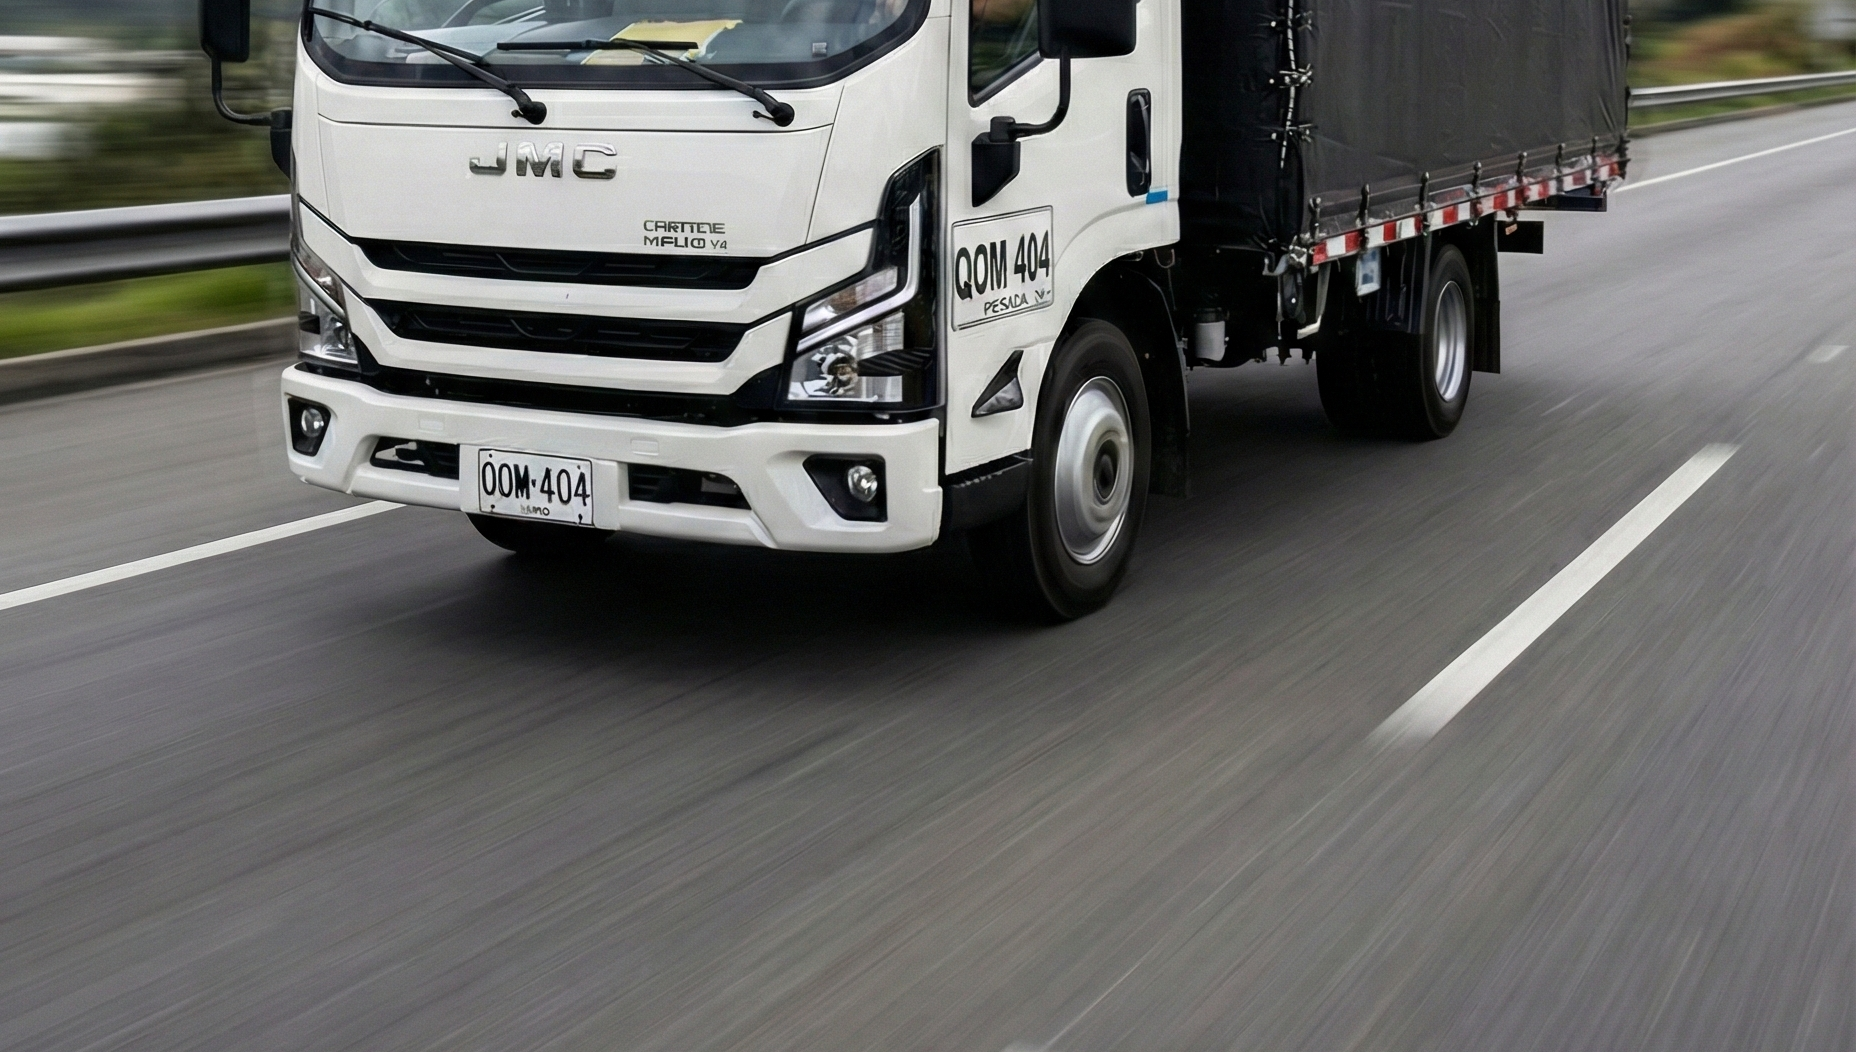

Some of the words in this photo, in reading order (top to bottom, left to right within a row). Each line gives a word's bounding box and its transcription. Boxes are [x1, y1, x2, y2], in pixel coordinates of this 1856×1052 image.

[469, 141, 618, 180] JMC
[955, 239, 1008, 301] QOM
[1013, 229, 1050, 284] 404
